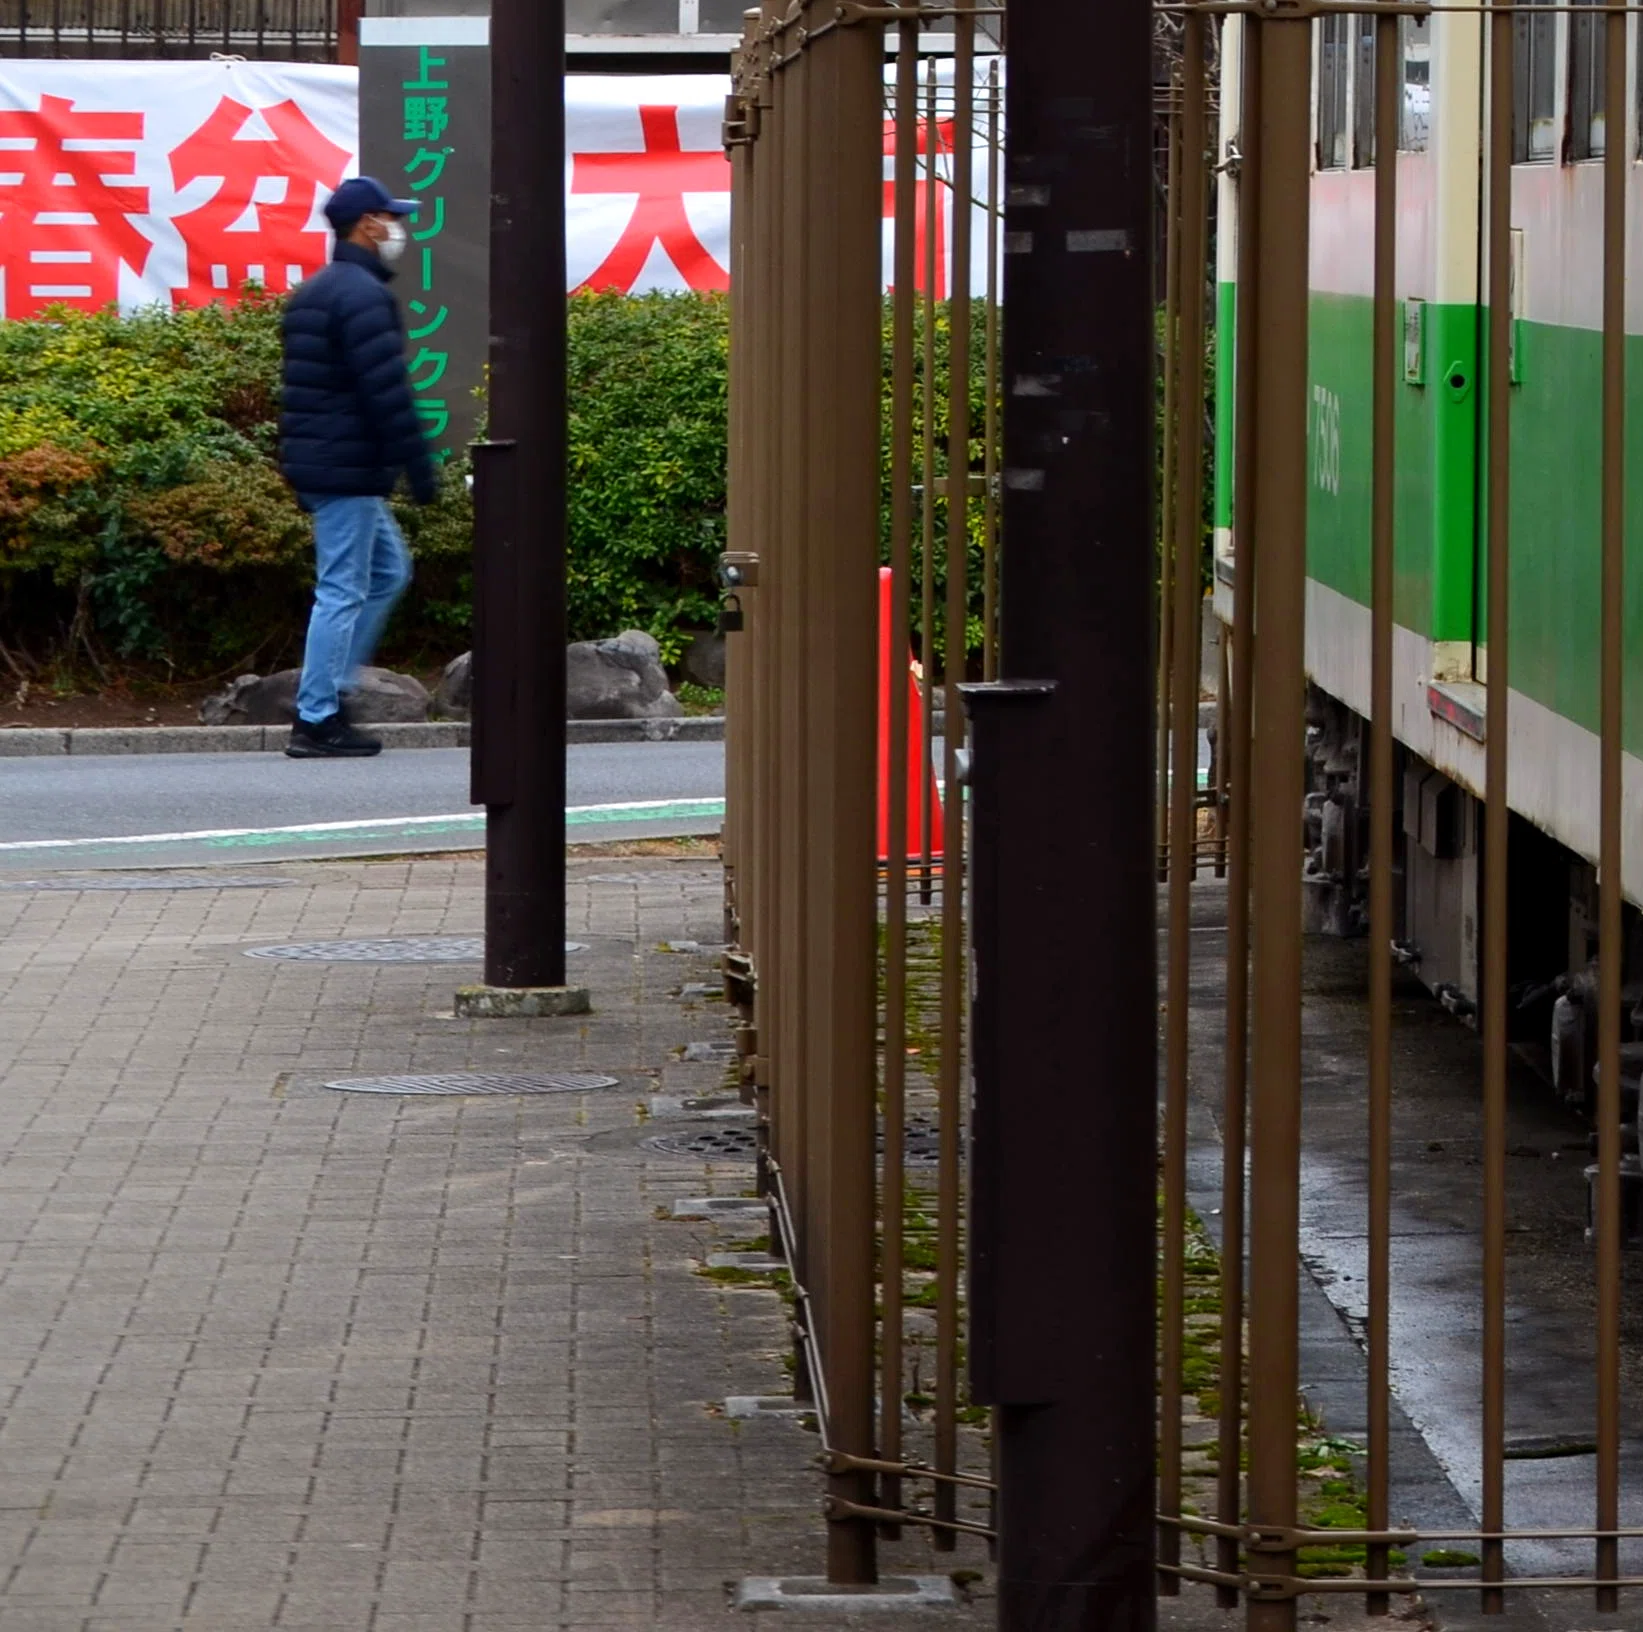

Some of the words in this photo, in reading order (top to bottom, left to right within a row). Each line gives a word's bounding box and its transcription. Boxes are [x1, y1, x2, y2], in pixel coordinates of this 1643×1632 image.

[402, 45, 455, 468] 上野グリーンクラ
